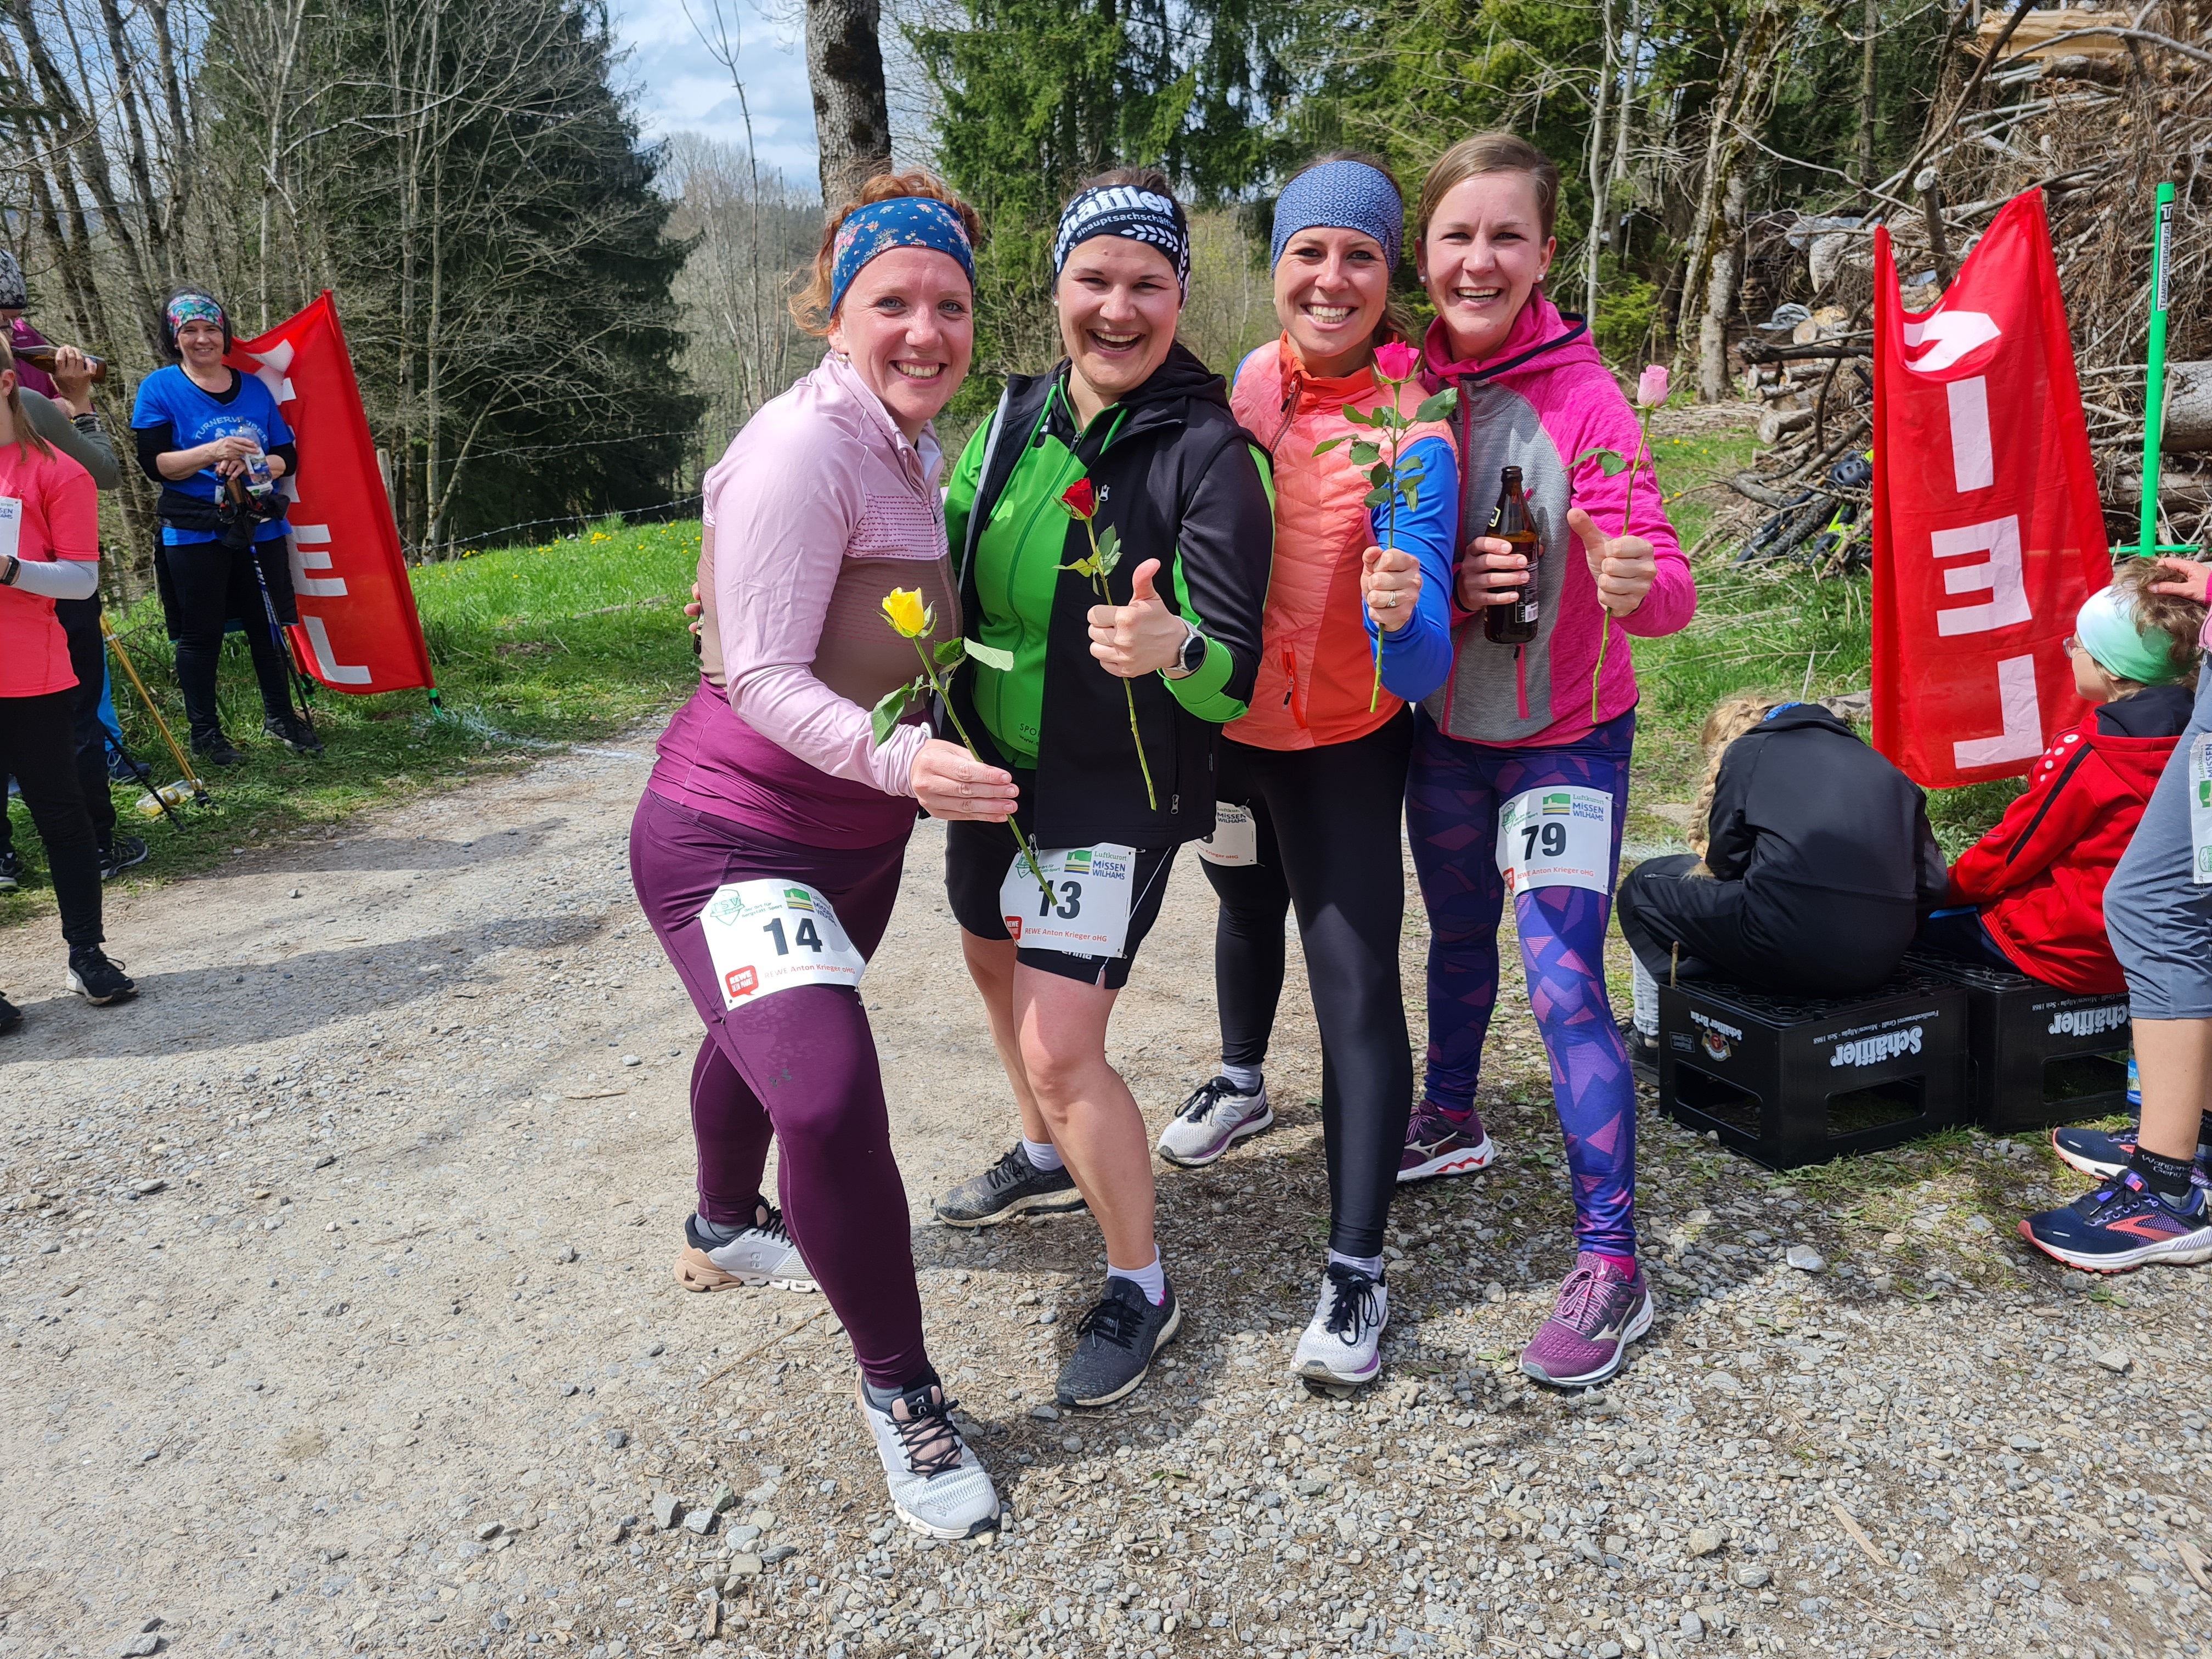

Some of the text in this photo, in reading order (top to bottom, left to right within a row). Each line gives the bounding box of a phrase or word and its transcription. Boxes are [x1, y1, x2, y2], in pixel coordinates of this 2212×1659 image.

[1054, 185, 1174, 273] Schäffler
[1572, 794, 1604, 805] Luftkurort
[1572, 811, 1604, 822] WILHAMS
[1521, 822, 1566, 861] 79
[1094, 851, 1127, 861] Luftkurort
[1205, 850, 1224, 858] Krieger
[1092, 868, 1125, 880] WILHAMS
[1553, 866, 1579, 874] Krieger
[713, 896, 740, 912] TSV
[1039, 879, 1082, 919] 13
[763, 917, 823, 956] 14
[1042, 928, 1063, 936] Anton
[1065, 931, 1091, 940] Krieger
[729, 970, 752, 985] REWE
[765, 968, 787, 979] REWE
[791, 964, 815, 973] Anton
[816, 964, 840, 973] Krieger
[1690, 1011, 1742, 1041] Schäffler Bräu
[2048, 1003, 2132, 1036] chäffler
[1813, 1010, 1939, 1045] Familienbrauerei Graßl Missen/Allgäu Seit 1868
[1830, 1025, 1923, 1067] Schäffler
